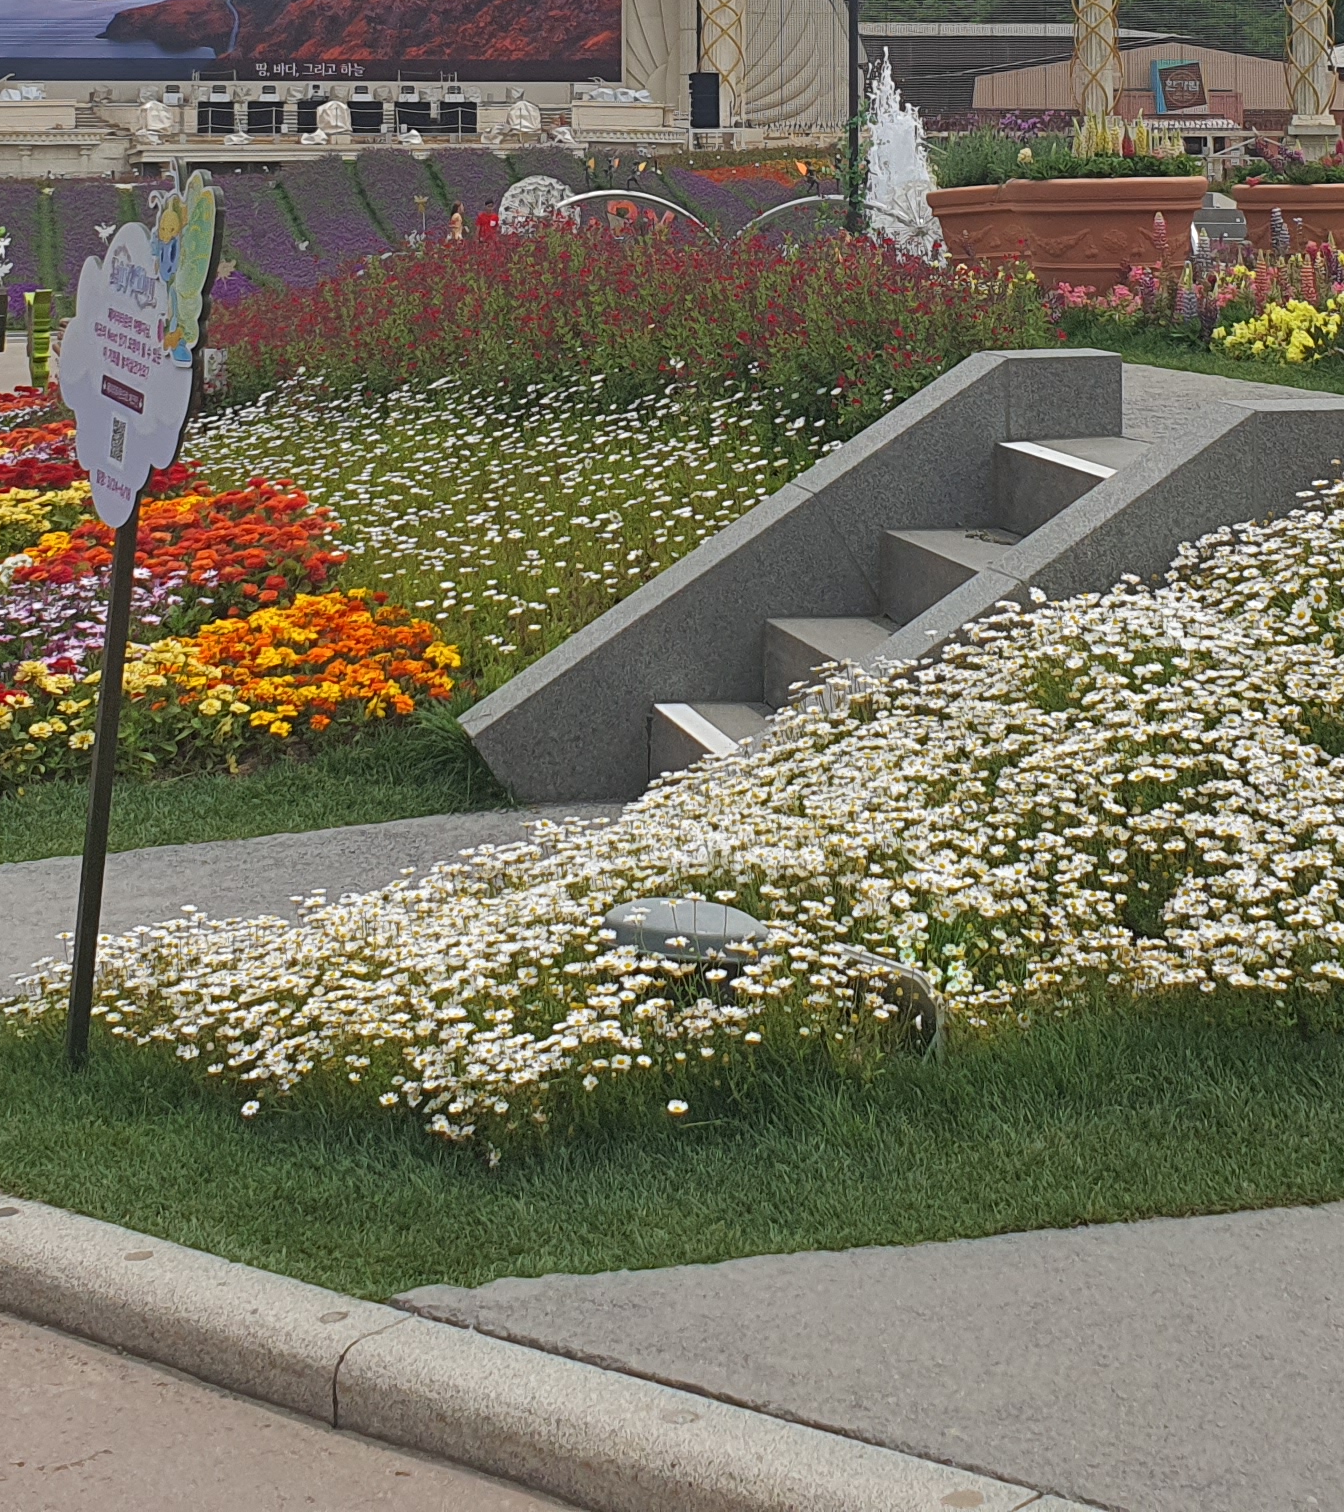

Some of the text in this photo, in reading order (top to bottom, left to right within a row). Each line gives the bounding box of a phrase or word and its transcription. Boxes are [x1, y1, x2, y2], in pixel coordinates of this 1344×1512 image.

[255, 62, 366, 77] 땅, 바다, 그리고 하늘
